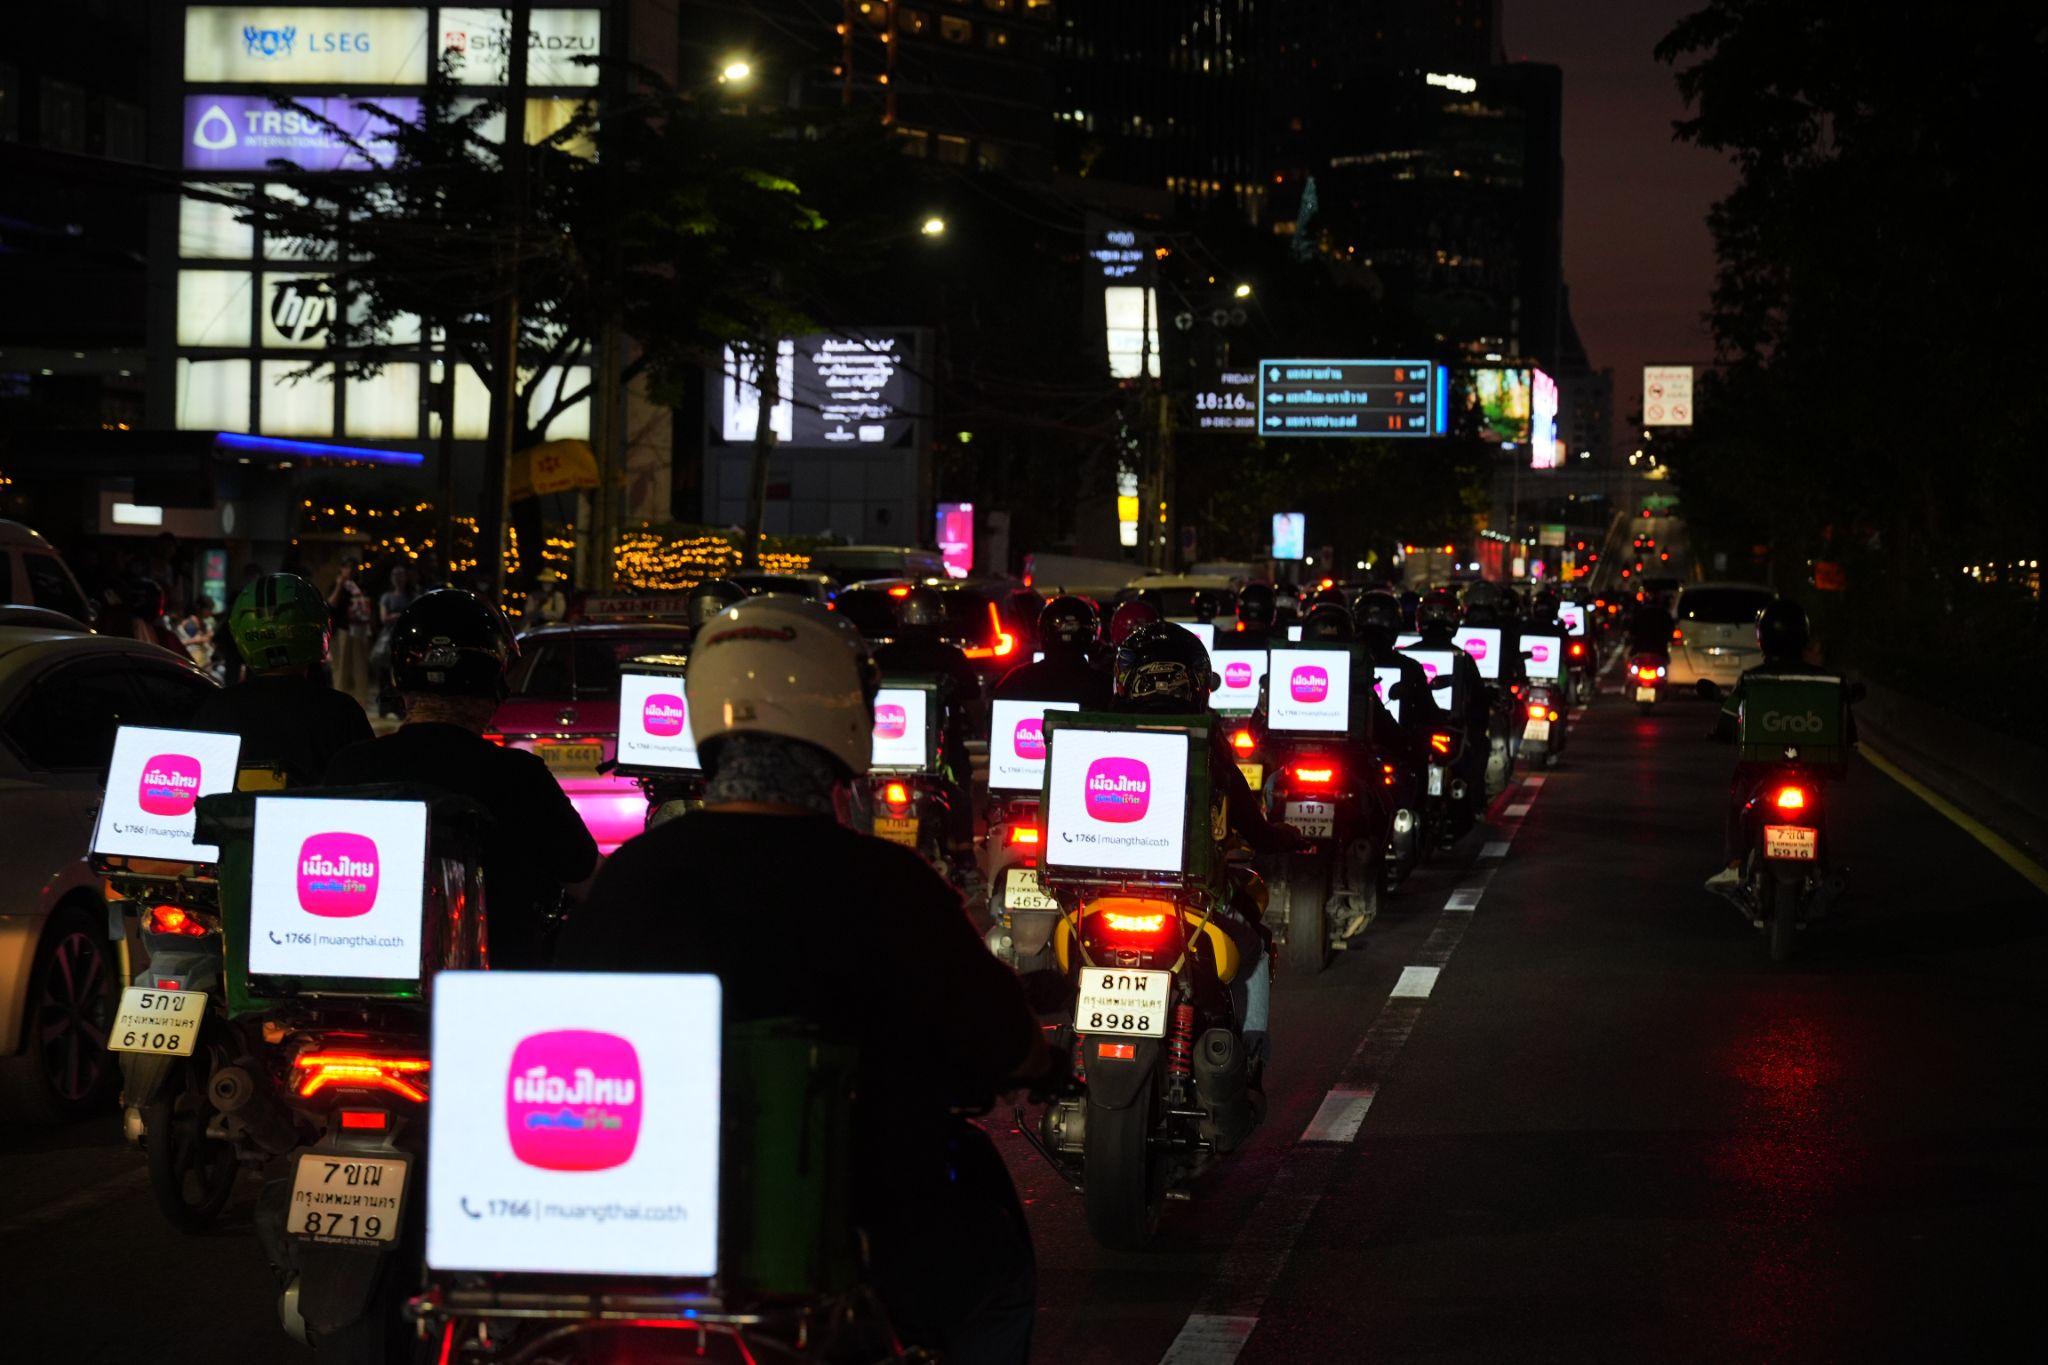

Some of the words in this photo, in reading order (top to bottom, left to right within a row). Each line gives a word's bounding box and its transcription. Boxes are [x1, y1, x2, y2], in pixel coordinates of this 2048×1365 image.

[309, 33, 370, 53] LSEG
[1221, 373, 1256, 384] FRIDAY
[1195, 392, 1245, 409] 18:16
[1394, 392, 1404, 405] 7
[1388, 415, 1401, 429] 11
[1761, 710, 1823, 732] Grab
[144, 769, 197, 788] เมืองไทย
[1089, 773, 1147, 793] เมืองไทย
[125, 824, 144, 834] 1766
[1075, 834, 1096, 843] 1766
[1102, 834, 1170, 847] muangthai.co.th
[302, 855, 374, 877] เมืองไทย
[1013, 896, 1051, 908] 4657
[285, 933, 311, 944] 1766
[319, 934, 404, 948] muangthai.co.th
[140, 994, 186, 1011] 5กข
[1084, 996, 1162, 1009] กรุงเทพมหานคร
[120, 1015, 195, 1028] กรุงเทพมหานคร
[1090, 1013, 1150, 1031] 8988
[123, 1031, 180, 1050] 6108
[513, 1066, 636, 1106] เมืองไทย
[324, 1163, 384, 1187] 7ขณ
[296, 1191, 396, 1209] กรุงเทพมหานคร
[487, 1199, 531, 1218] 1766
[545, 1201, 688, 1224] muangthai.co.th
[305, 1212, 381, 1238] 8719
